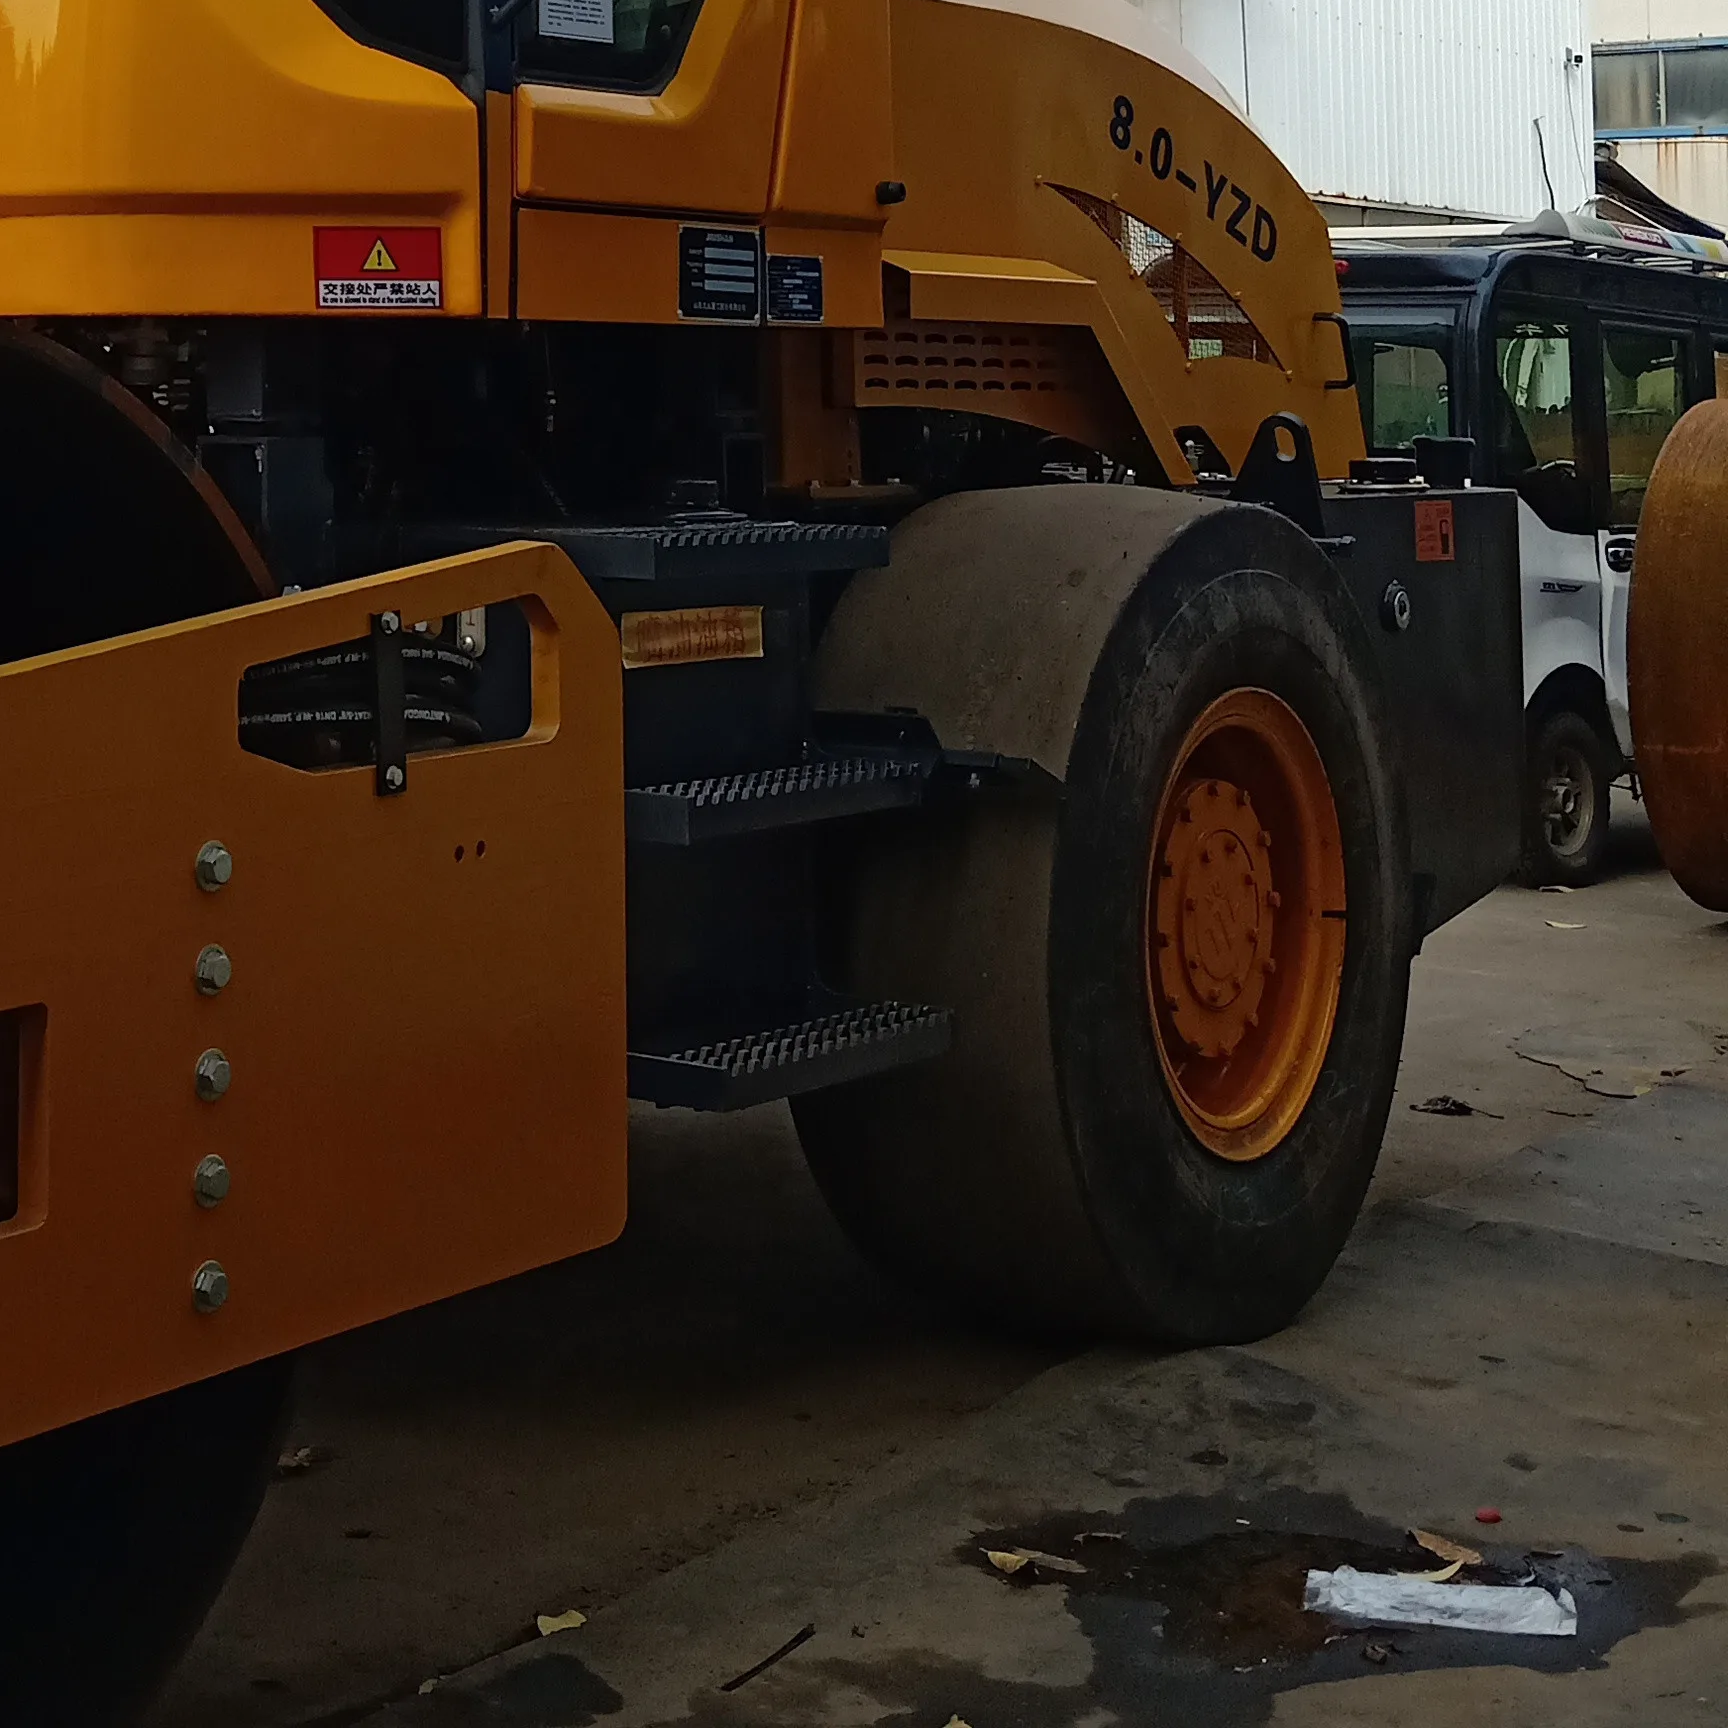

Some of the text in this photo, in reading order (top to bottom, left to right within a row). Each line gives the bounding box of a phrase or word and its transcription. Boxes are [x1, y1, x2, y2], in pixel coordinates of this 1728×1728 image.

[323, 282, 437, 295] 交接处严禁站人
